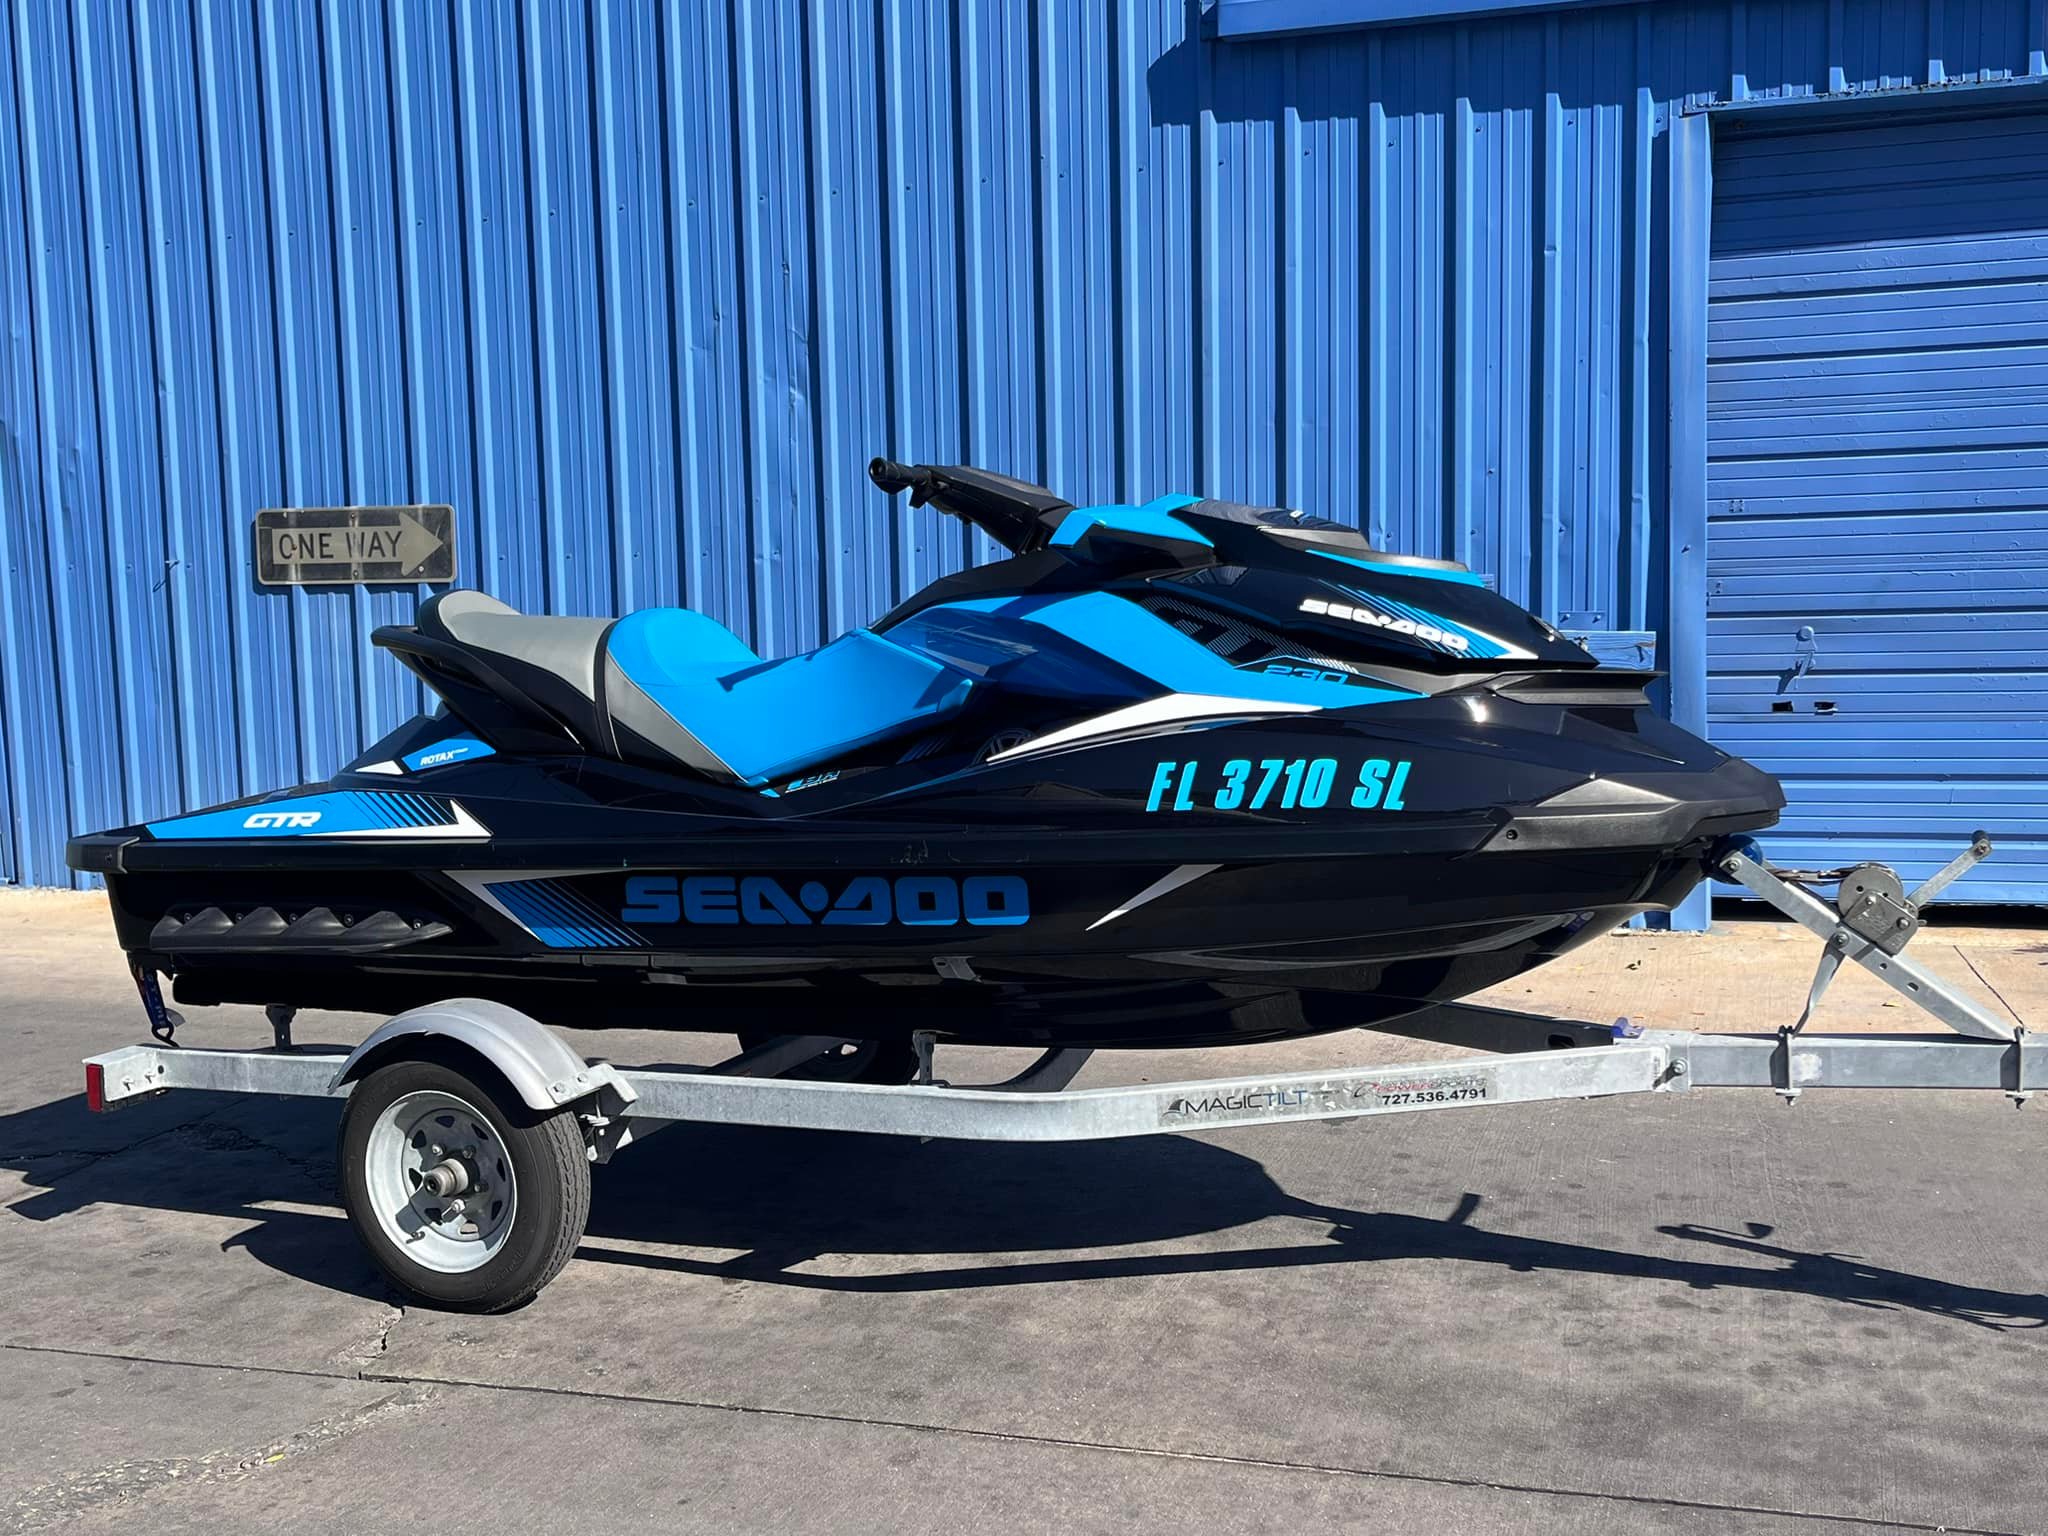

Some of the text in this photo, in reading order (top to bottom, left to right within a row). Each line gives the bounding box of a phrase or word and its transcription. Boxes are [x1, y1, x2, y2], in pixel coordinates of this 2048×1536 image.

[278, 530, 402, 560] ONE WAY
[1263, 664, 1350, 685] 230
[420, 750, 455, 766] ROTAX
[1146, 758, 1412, 812] FL 3710 SL
[243, 811, 322, 829] GTR
[1382, 1087, 1488, 1106] 727.536.4791
